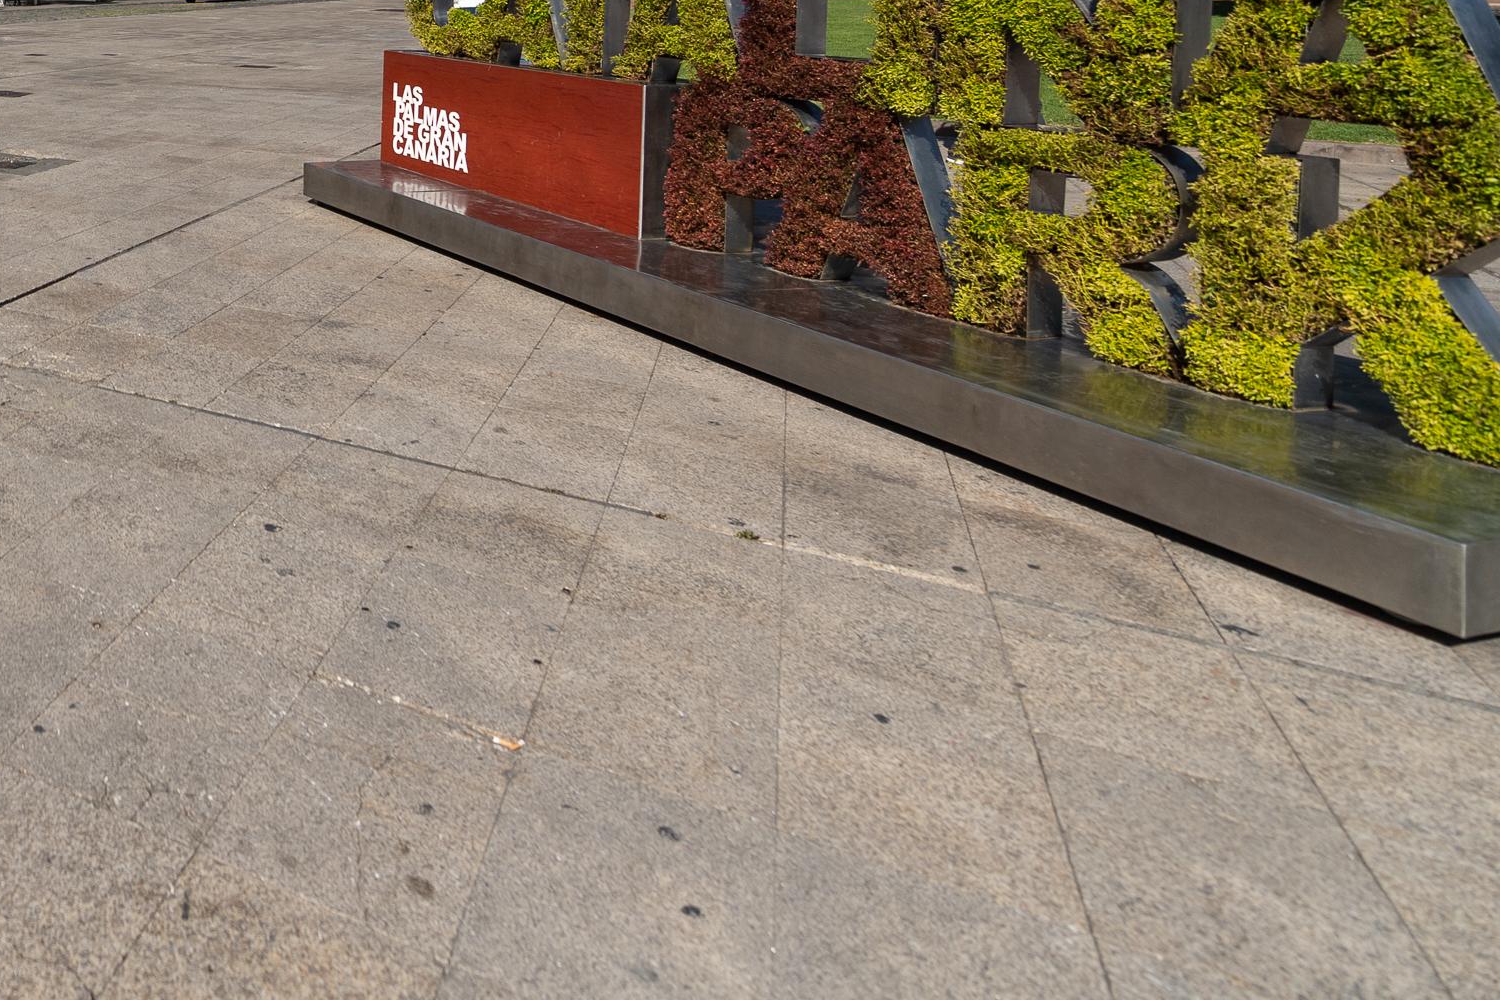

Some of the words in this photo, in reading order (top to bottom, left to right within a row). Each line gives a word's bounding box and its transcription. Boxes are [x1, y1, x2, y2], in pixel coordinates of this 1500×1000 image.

[392, 82, 423, 106] LAS
[395, 100, 461, 132] PALMAS
[393, 117, 414, 139] DE
[417, 124, 467, 153] GRAN
[392, 135, 469, 174] CANARIA
[663, 78, 1500, 464] PARK
